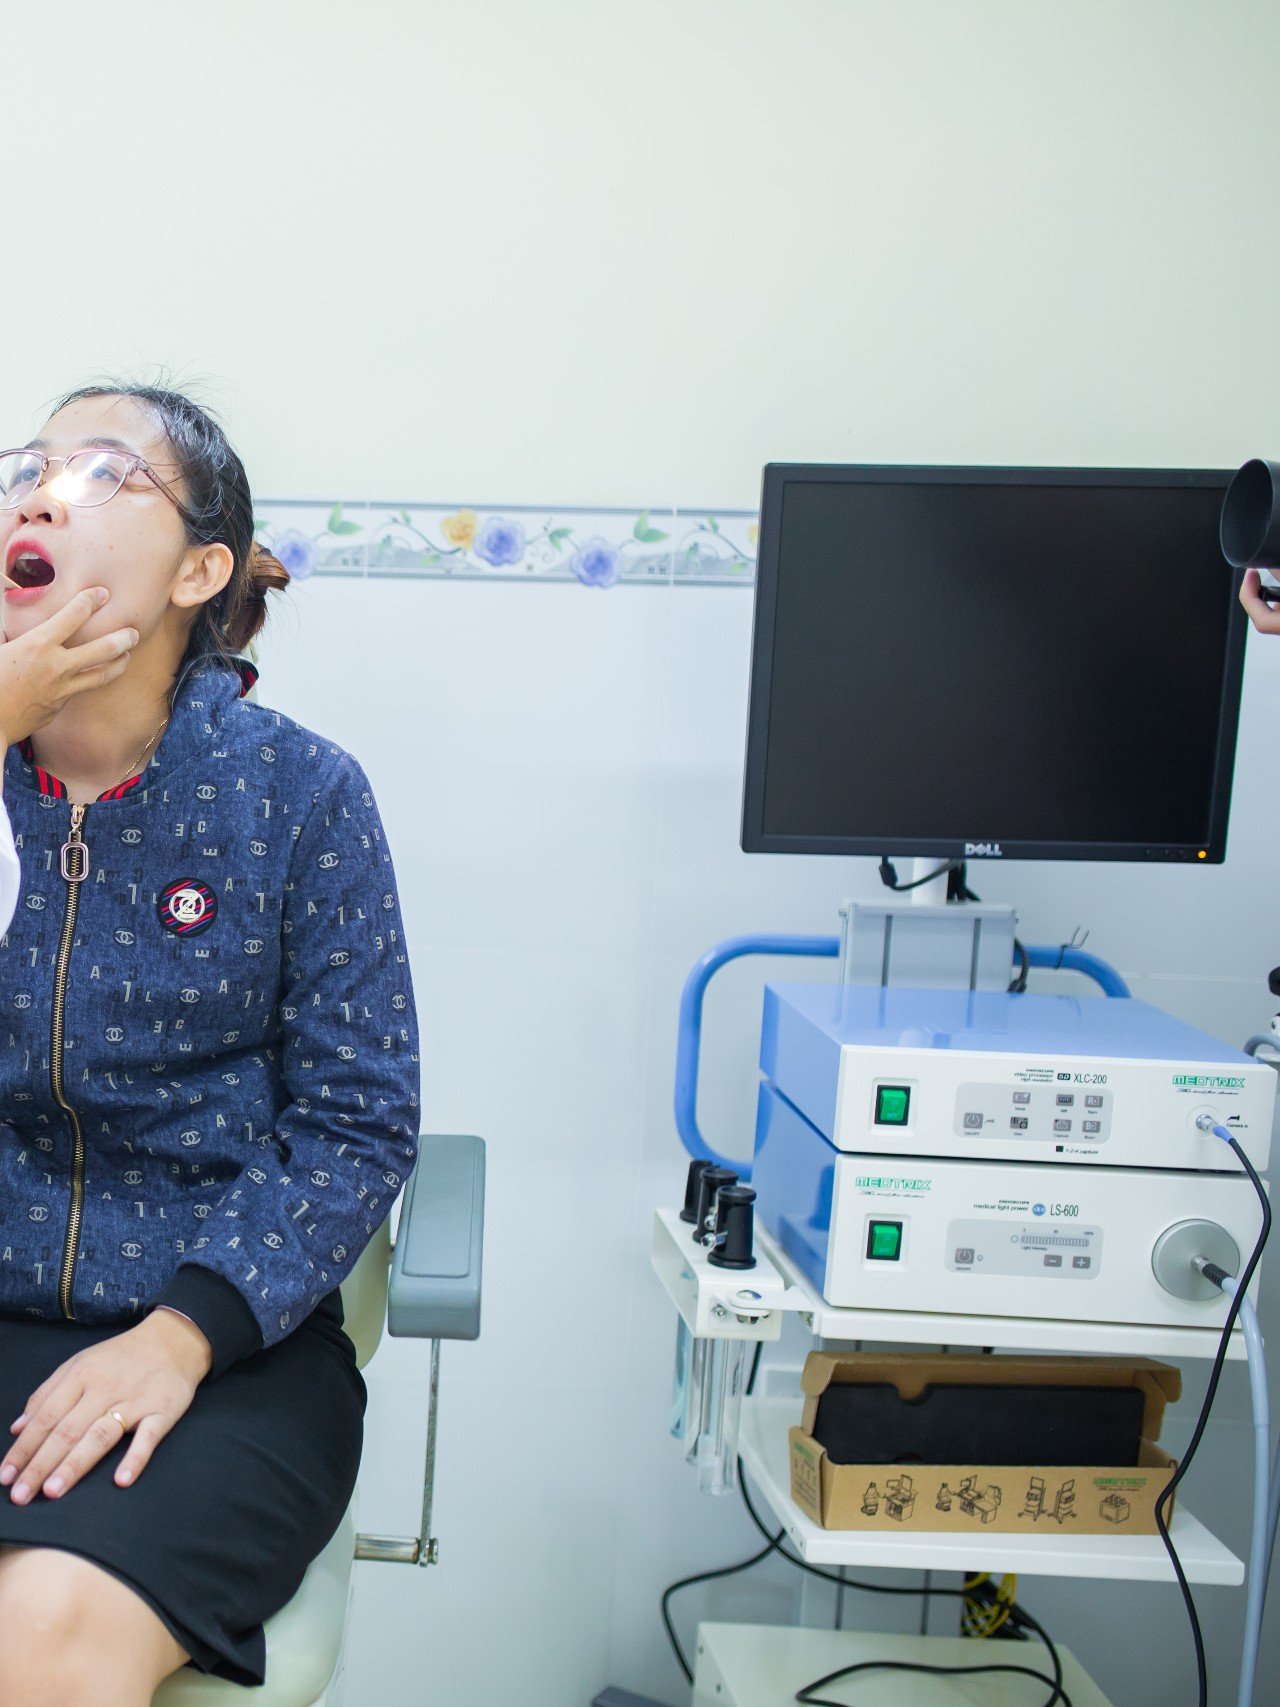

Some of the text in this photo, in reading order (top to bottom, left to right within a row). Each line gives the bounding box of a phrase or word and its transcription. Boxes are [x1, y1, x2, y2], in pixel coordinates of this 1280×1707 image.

[965, 843, 1003, 856] DELL
[1073, 1073, 1107, 1085] XLC-200
[1172, 1075, 1246, 1088] MEDTRIX
[855, 1176, 932, 1190] MEDTRIX
[1050, 1204, 1079, 1217] LS-600
